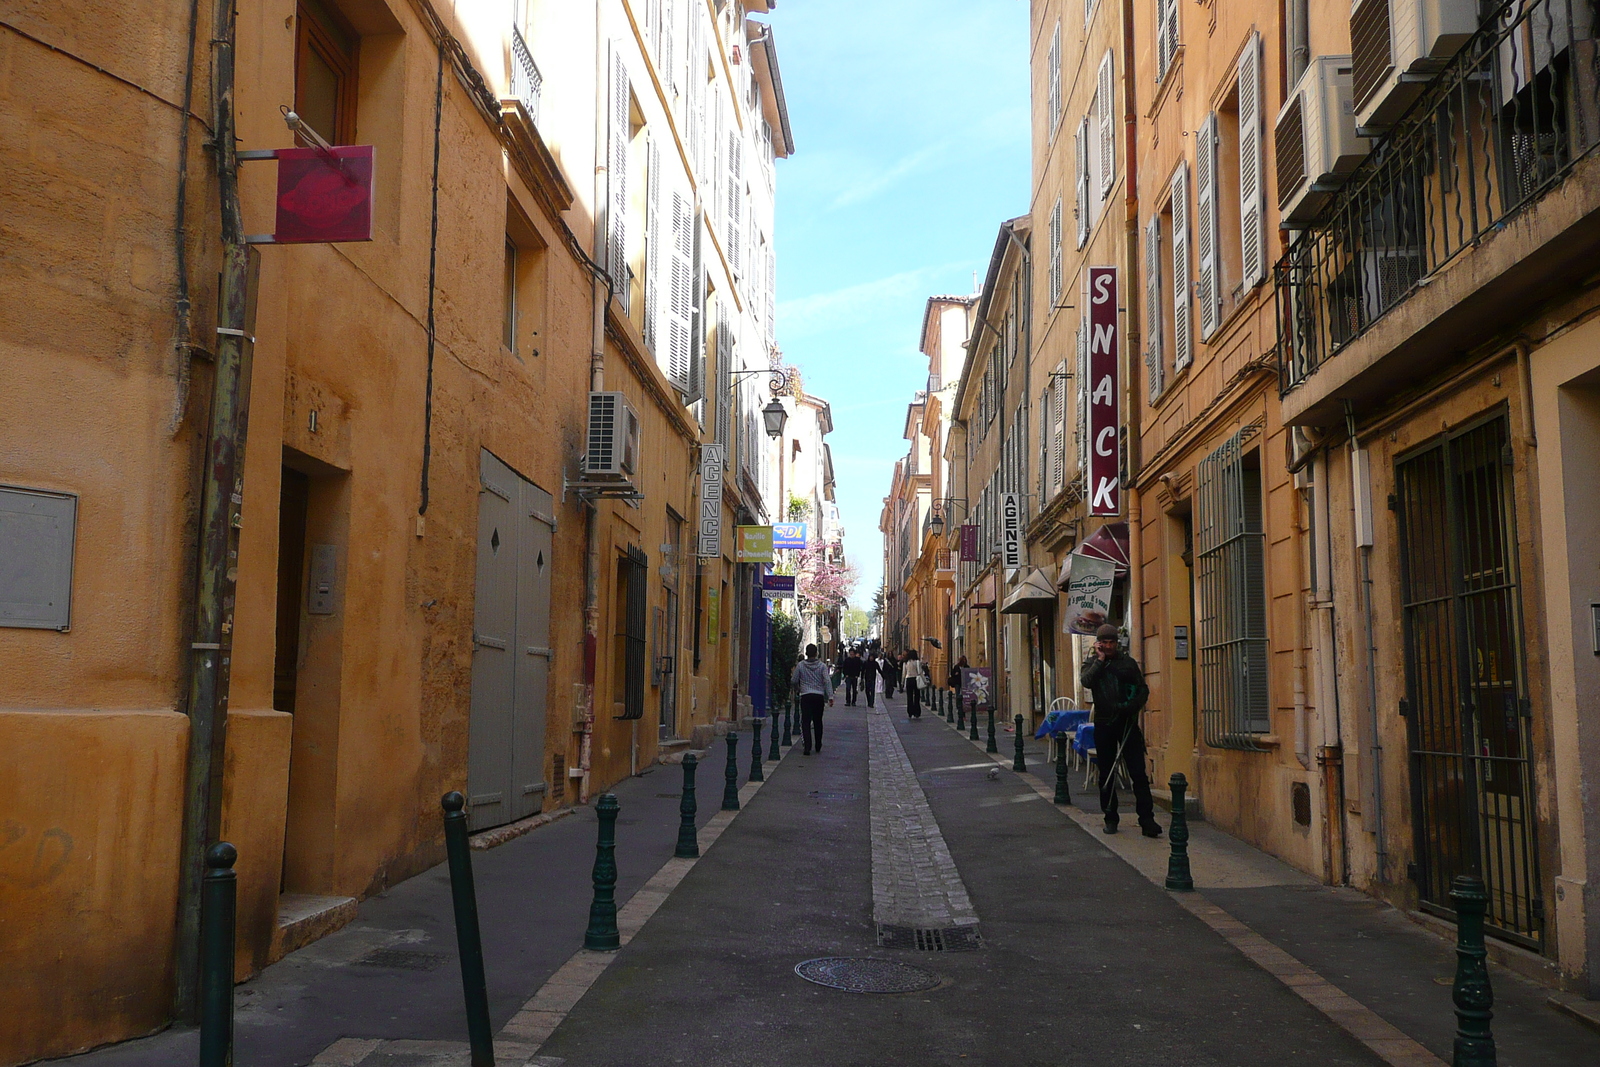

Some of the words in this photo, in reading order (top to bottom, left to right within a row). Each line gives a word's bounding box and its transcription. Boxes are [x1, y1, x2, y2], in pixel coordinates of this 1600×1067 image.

[1092, 274, 1118, 509] SNACK
[702, 446, 720, 557] AGENCE
[1004, 495, 1019, 565] AGENCE
[762, 591, 795, 599] locations
